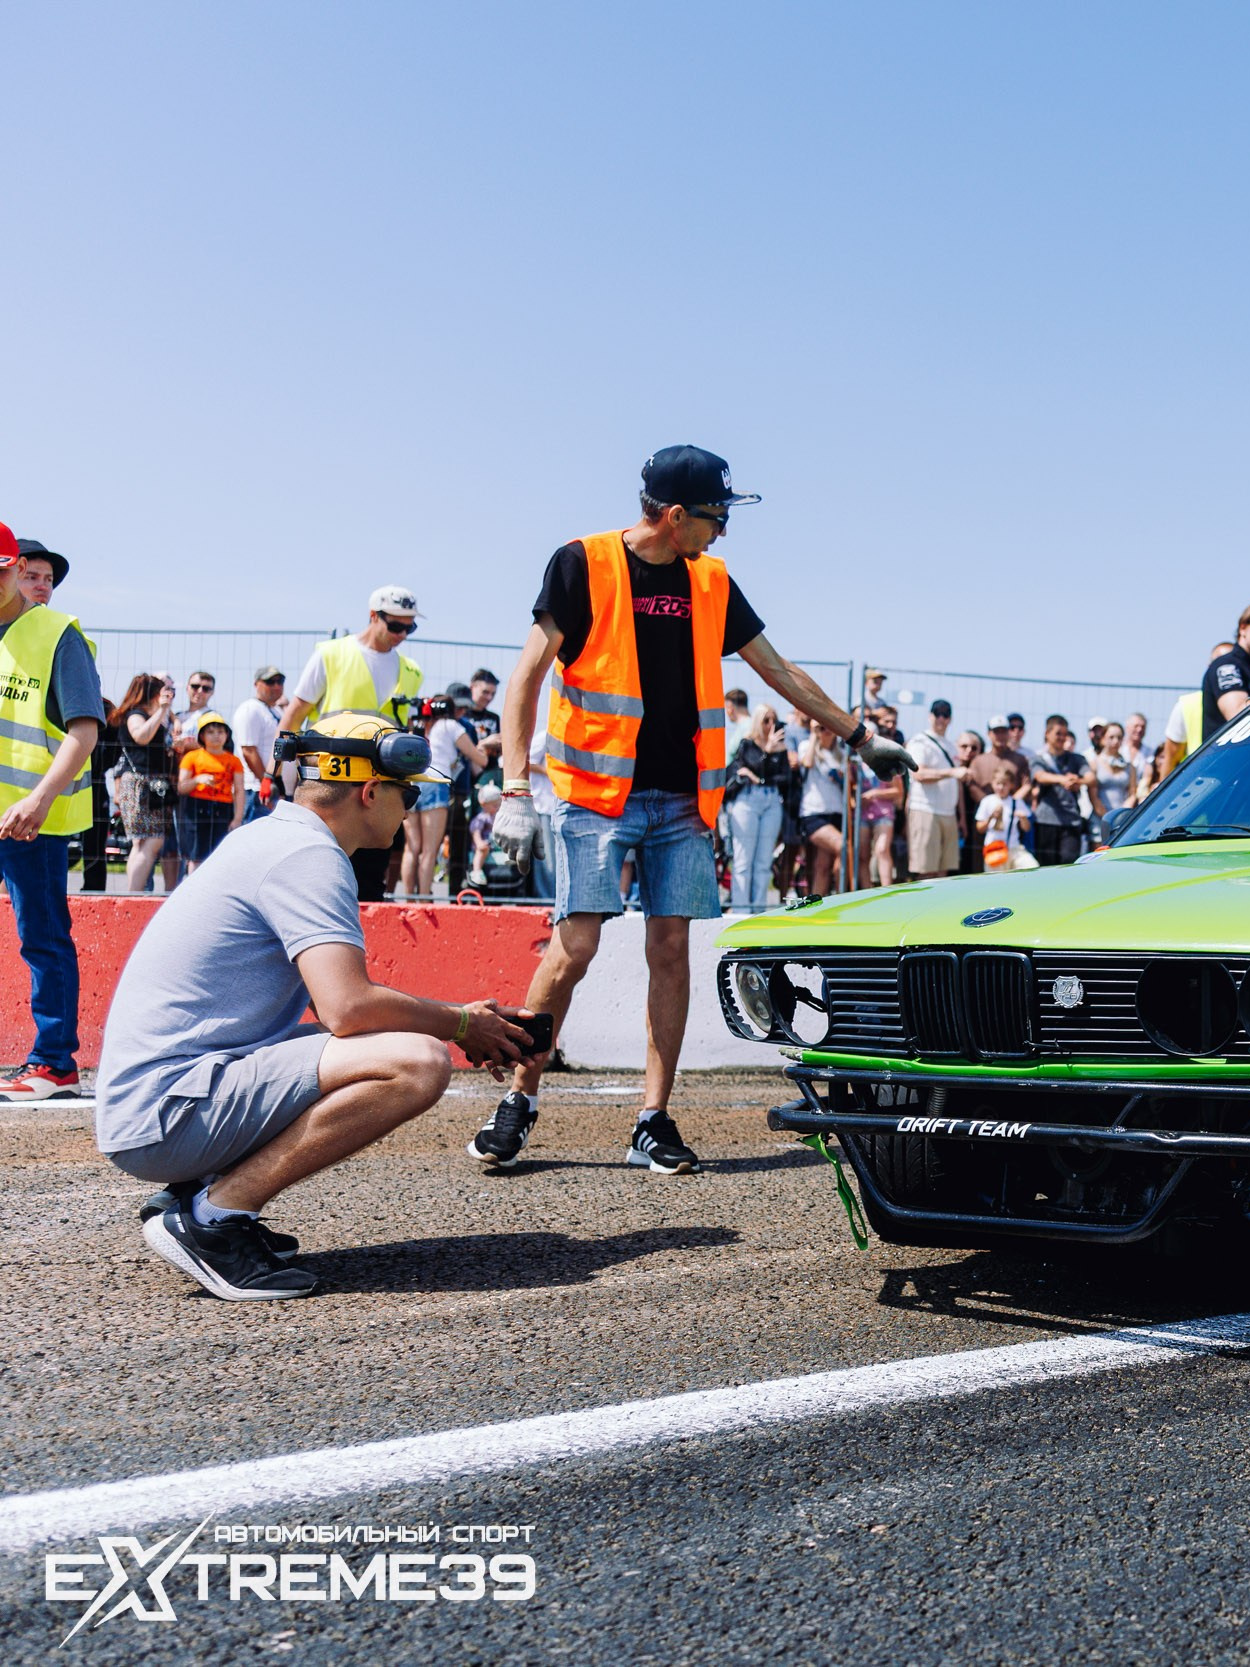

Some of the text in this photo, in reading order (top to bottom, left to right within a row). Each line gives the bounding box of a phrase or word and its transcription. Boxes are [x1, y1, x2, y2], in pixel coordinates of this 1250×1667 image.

[0, 686, 29, 702] УДЬЯ
[329, 757, 351, 777] 31
[897, 1116, 1032, 1139] DRIFT TEAM
